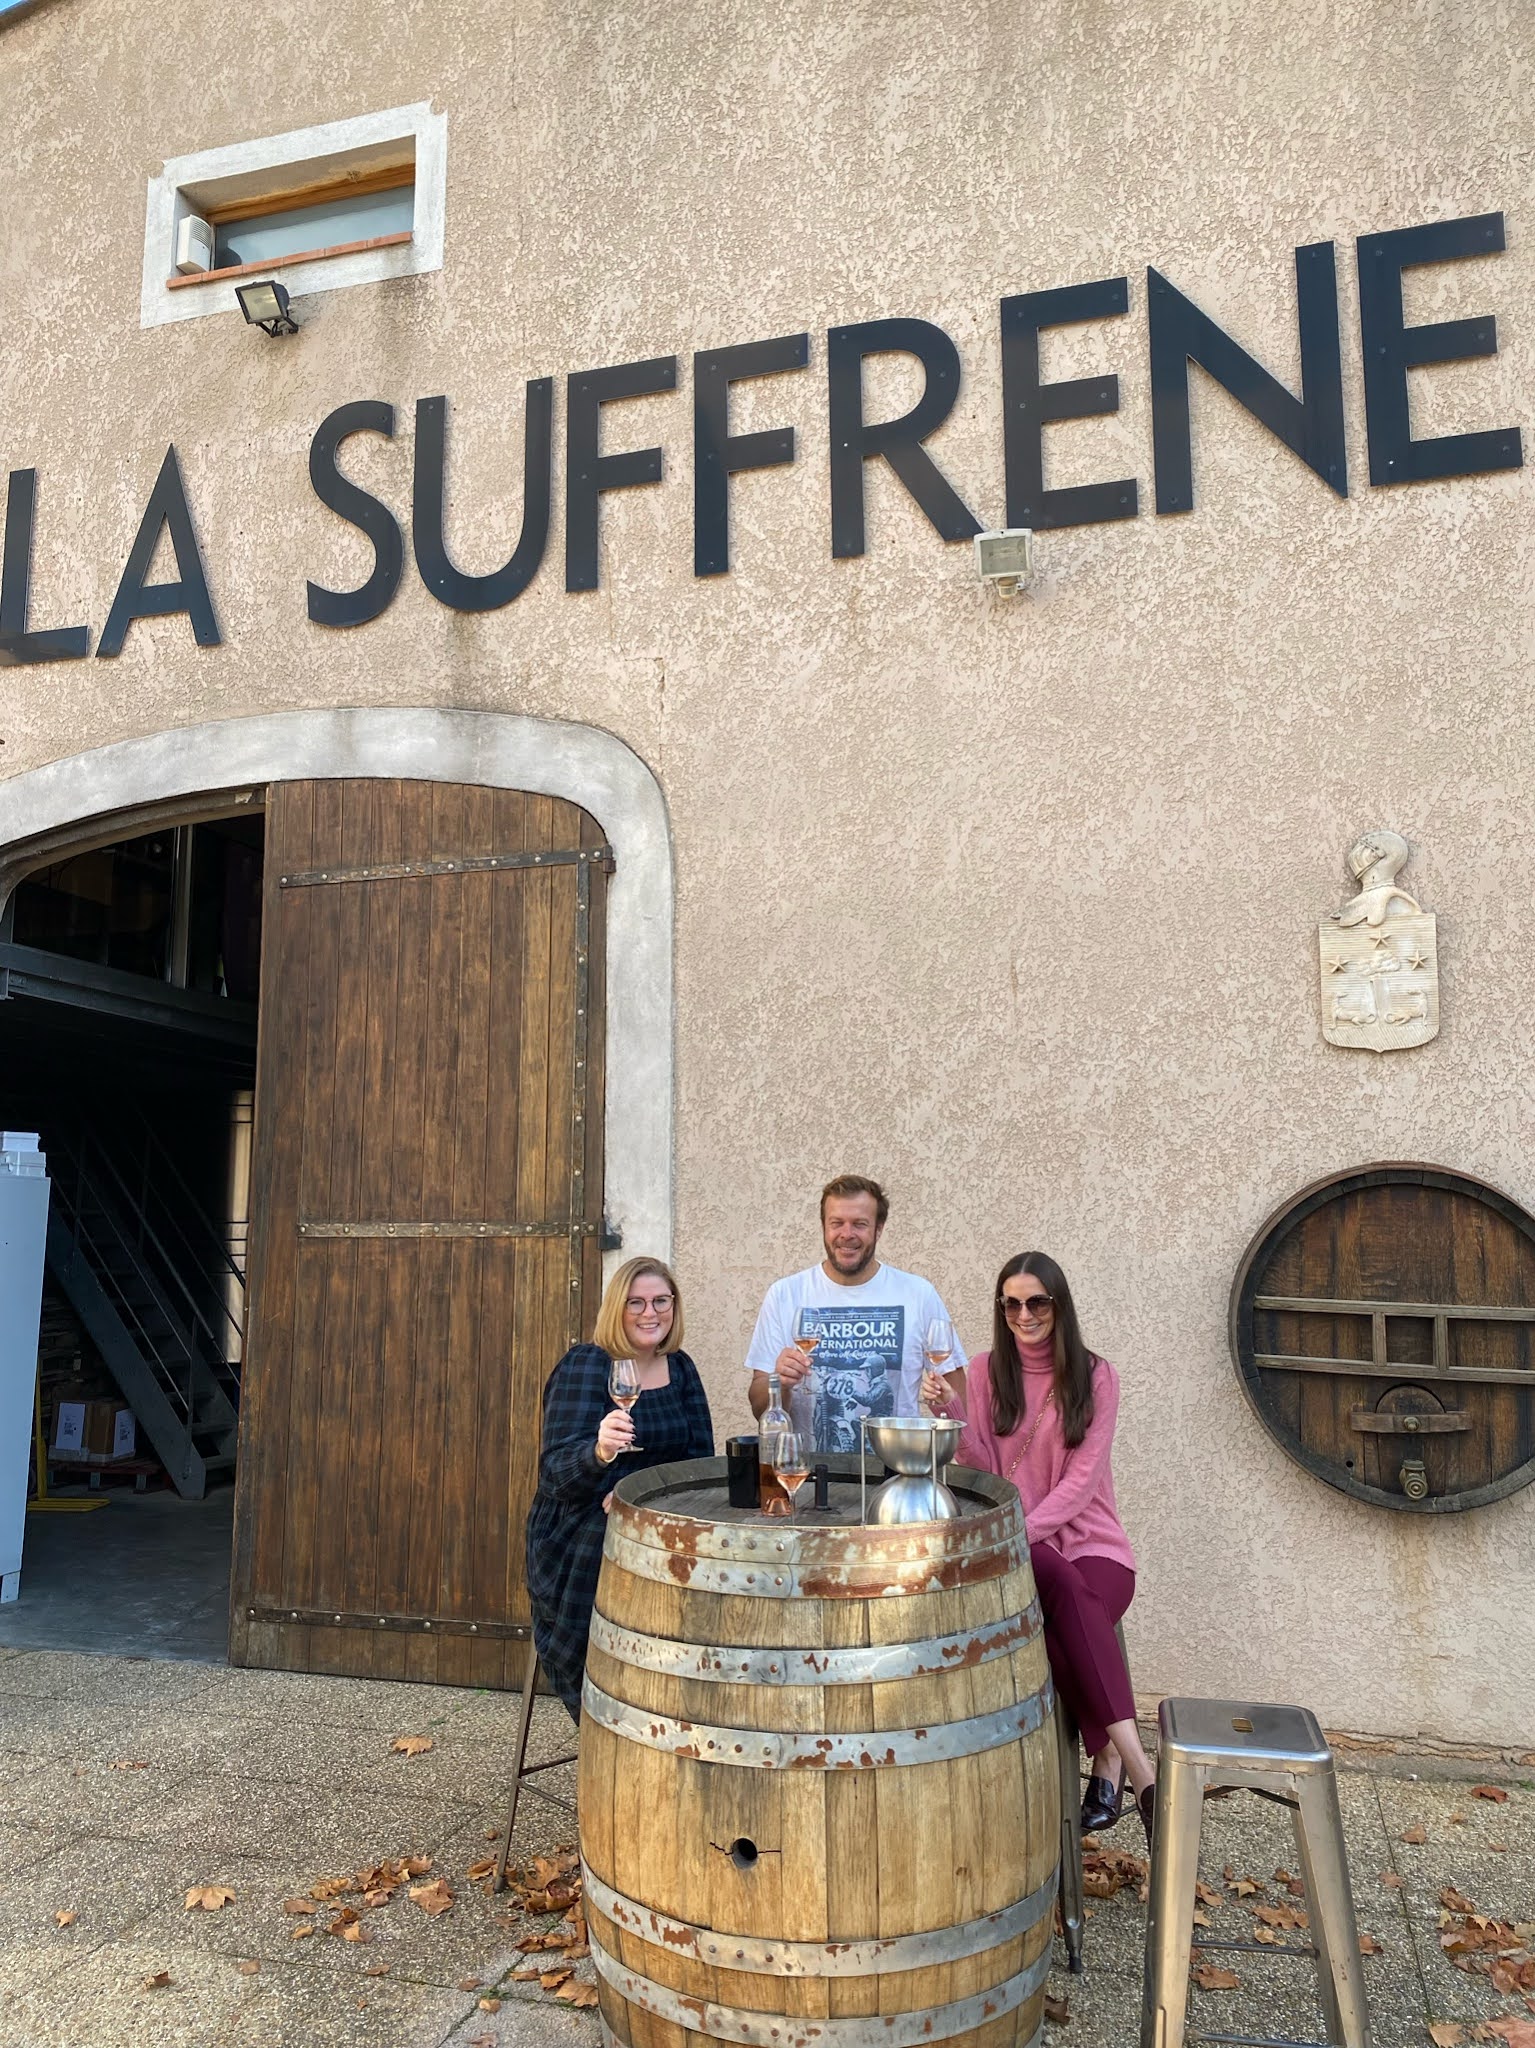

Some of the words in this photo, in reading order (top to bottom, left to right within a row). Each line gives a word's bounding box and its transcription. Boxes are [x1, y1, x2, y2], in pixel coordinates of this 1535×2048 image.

[0, 443, 222, 666] LA
[308, 211, 1524, 628] SUFFRENE
[803, 1321, 897, 1338] BARBOUR
[815, 1338, 898, 1350] TERNATIONAL
[829, 1378, 854, 1396] 278
